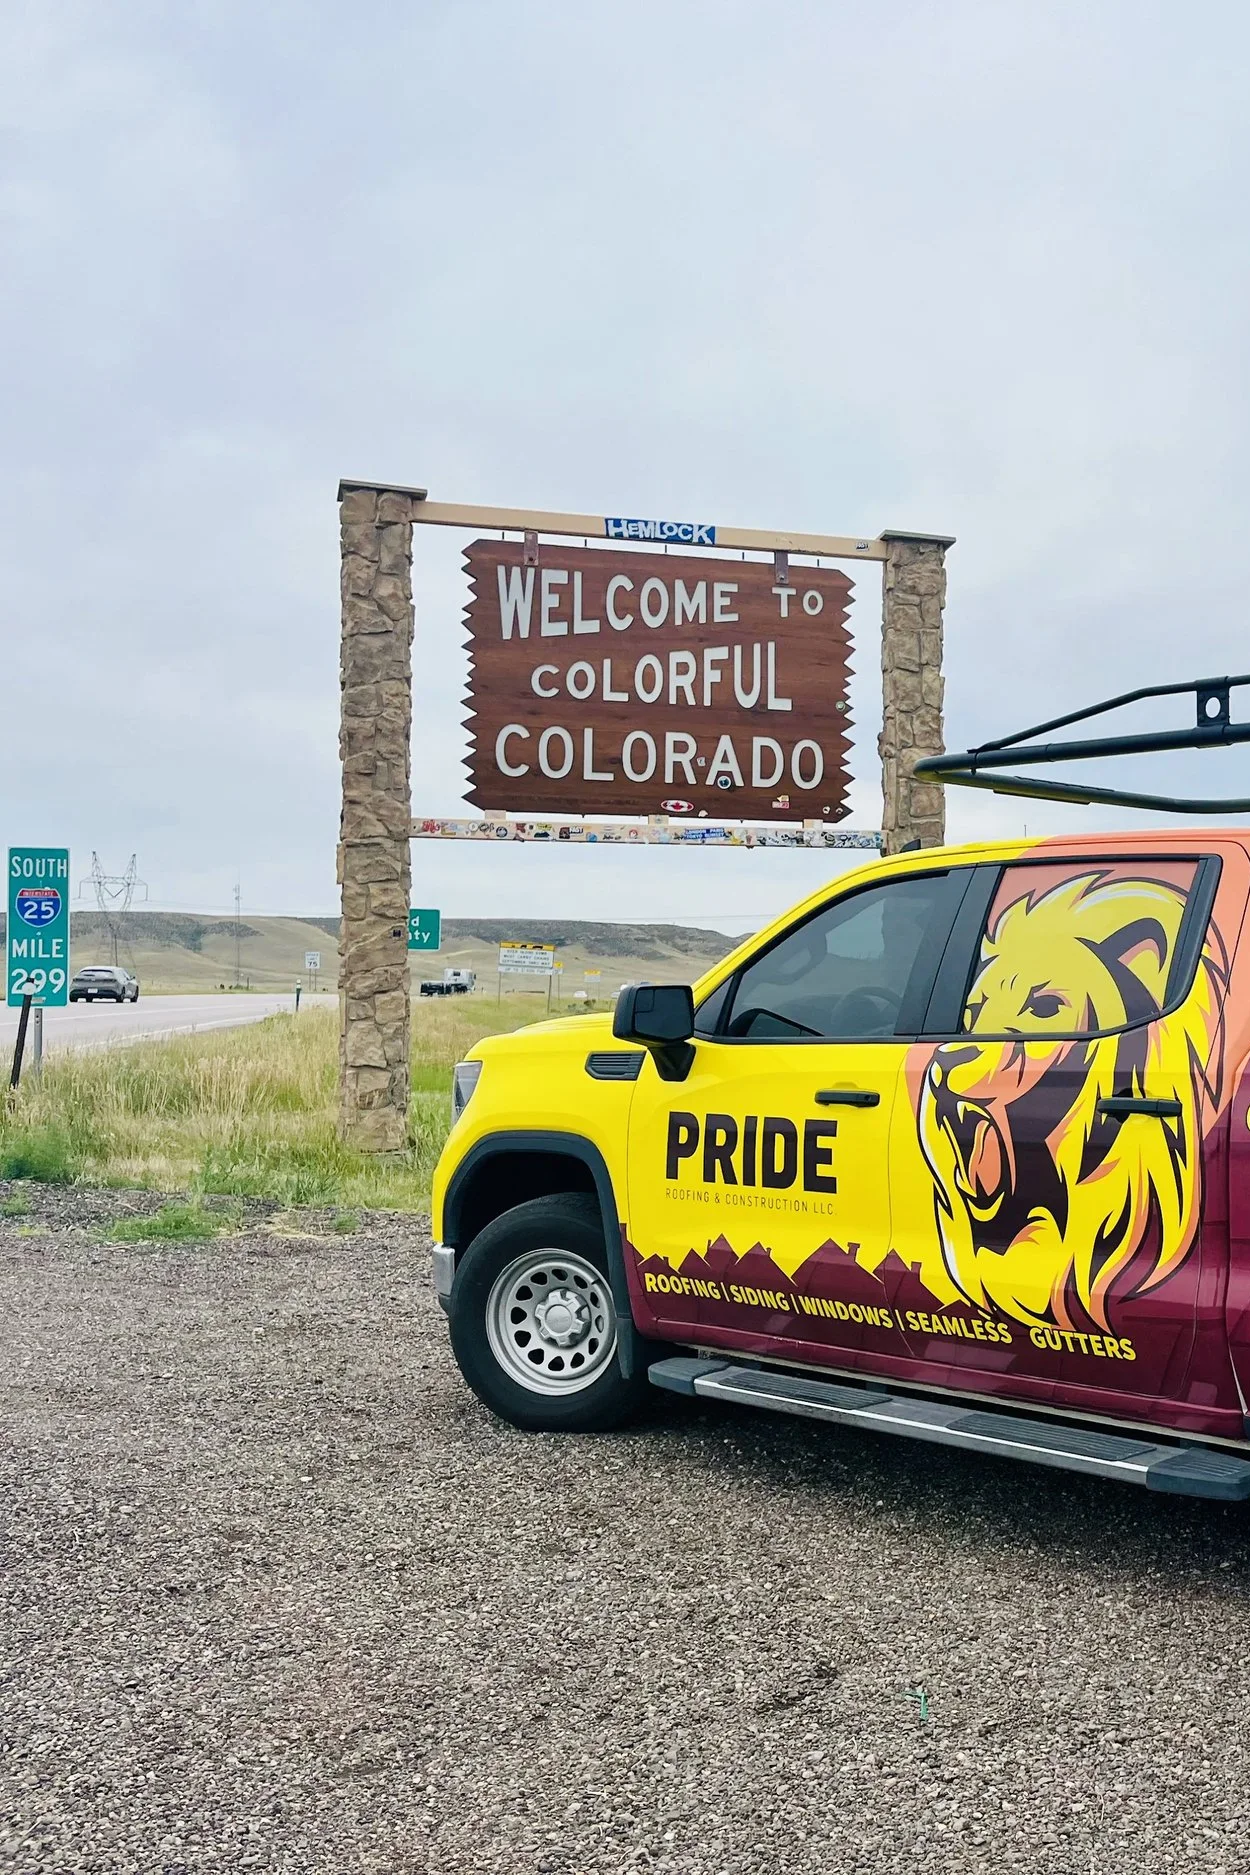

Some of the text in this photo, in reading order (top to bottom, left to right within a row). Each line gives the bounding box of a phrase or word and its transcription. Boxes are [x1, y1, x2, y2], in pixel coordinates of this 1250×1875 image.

[607, 518, 714, 545] HEMLOCK
[496, 564, 824, 640] WELCOME TO
[530, 640, 793, 712] COLORFUL
[494, 723, 825, 790] COLORADO
[11, 855, 67, 878] SOUTH
[23, 901, 55, 919] 25
[12, 938, 64, 958] MILE
[11, 968, 66, 995] 299
[664, 1111, 838, 1195] PRIDE
[665, 1187, 710, 1203] ROOFING
[714, 1192, 721, 1204] &
[725, 1193, 808, 1213] CONSTRUCTION
[645, 1271, 721, 1301] ROOFING
[732, 1284, 788, 1312] SIDING
[798, 1295, 896, 1331] WINDOWS
[908, 1311, 1013, 1345] SEAMLESS
[1029, 1325, 1137, 1361] GUTTERS
